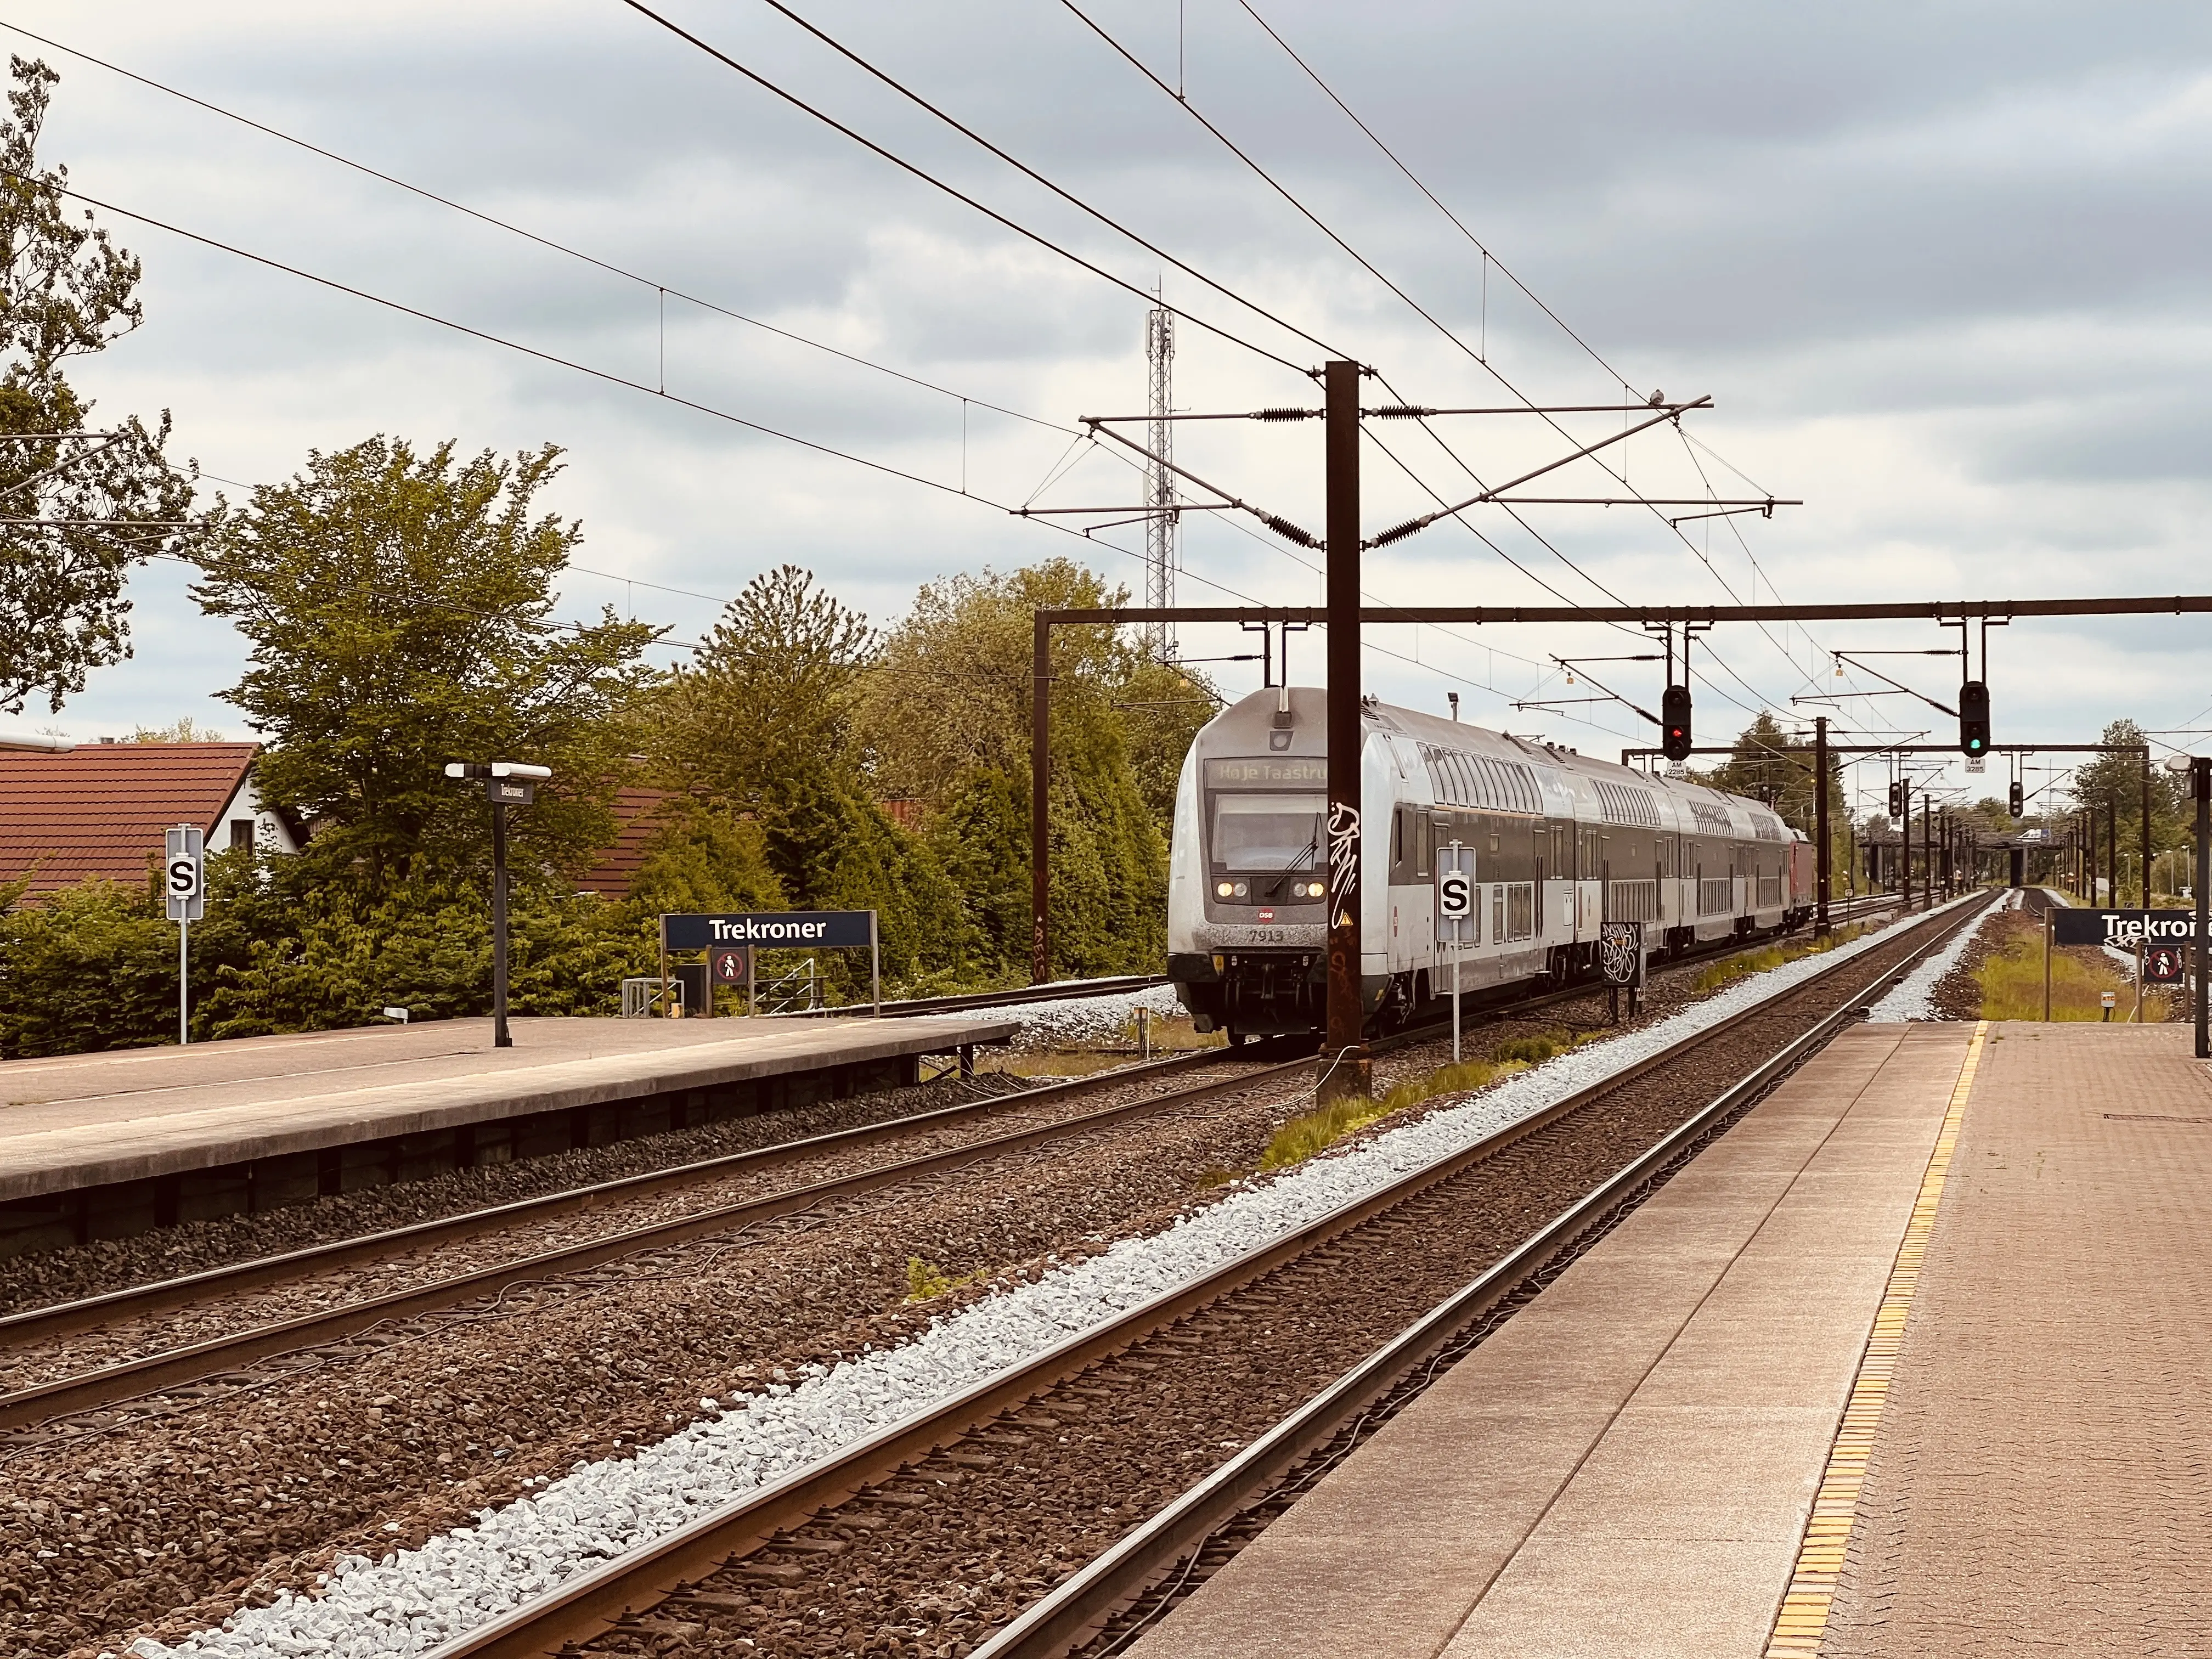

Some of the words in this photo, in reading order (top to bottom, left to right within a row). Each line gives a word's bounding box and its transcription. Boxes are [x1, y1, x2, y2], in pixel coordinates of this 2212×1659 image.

[1263, 765, 1328, 780] Taastru
[170, 861, 194, 891] S
[1442, 879, 1468, 911] S
[709, 918, 826, 940] Trekroner
[2101, 915, 2212, 937] Trekro
